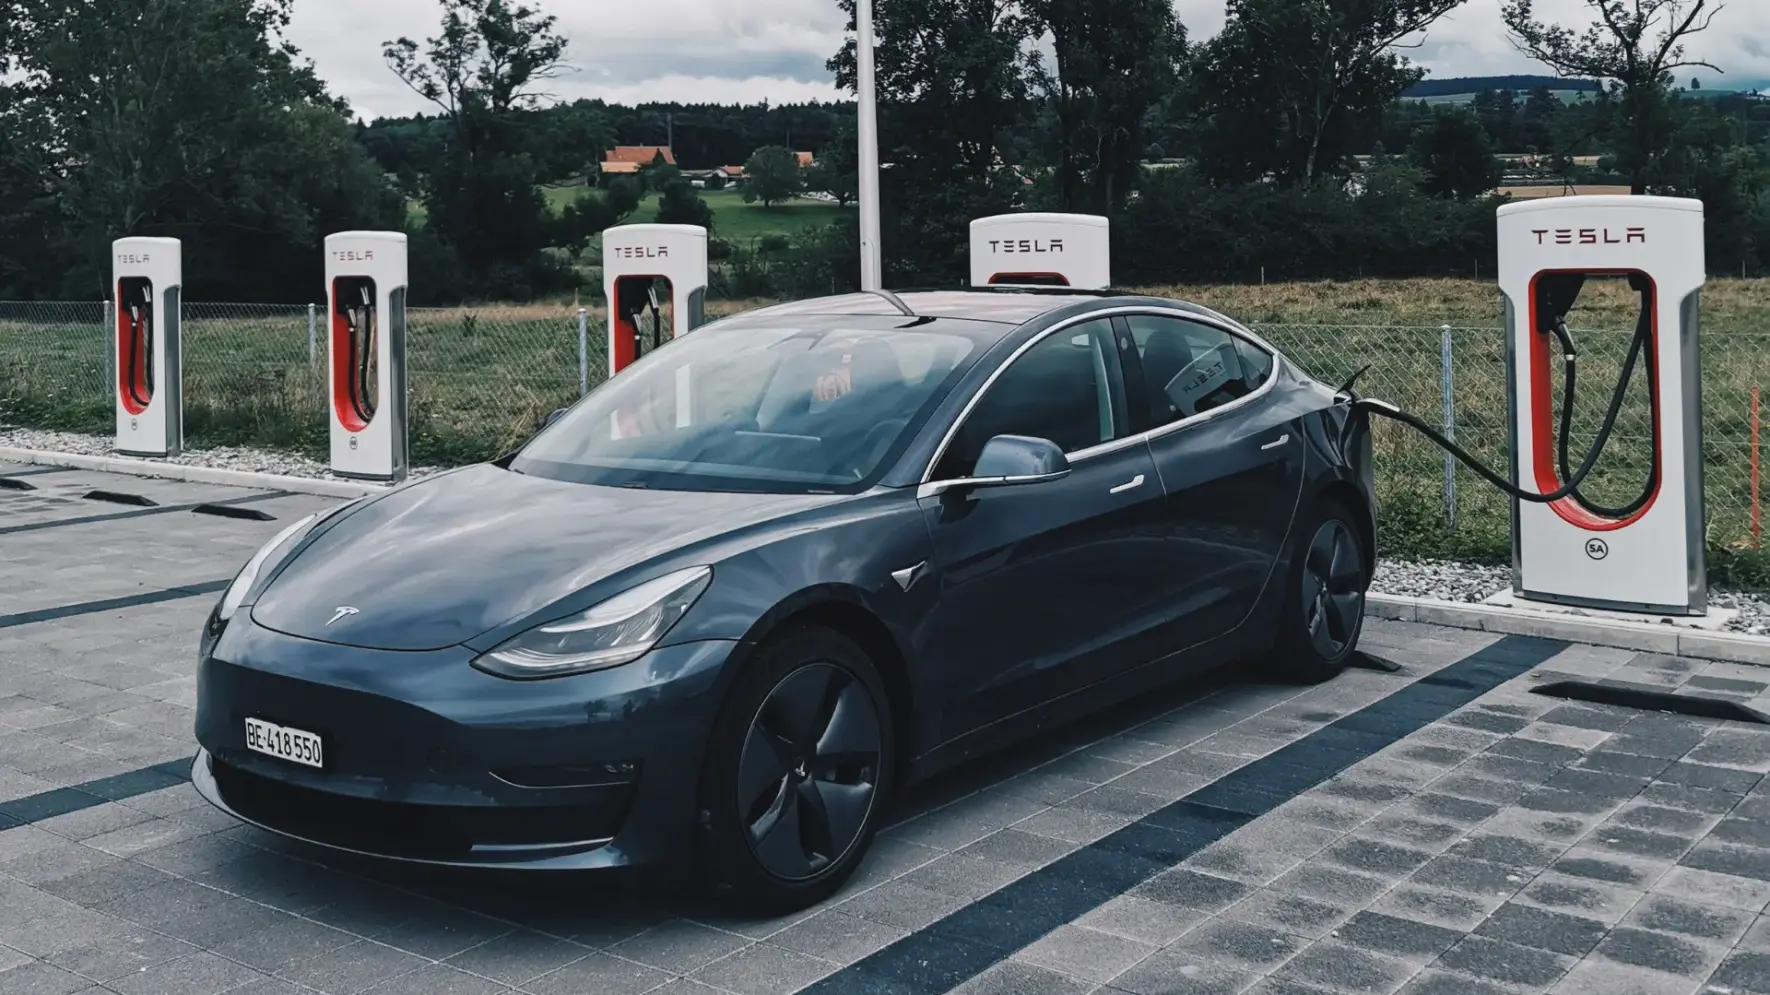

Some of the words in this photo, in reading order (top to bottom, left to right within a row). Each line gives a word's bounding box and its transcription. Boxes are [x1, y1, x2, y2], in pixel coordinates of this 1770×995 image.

[1531, 227, 1645, 244] TESLA
[989, 239, 1063, 253] TESLA
[332, 250, 373, 260] TESLA
[615, 246, 668, 258] TESLA
[117, 254, 150, 264] TESLA
[1589, 544, 1604, 554] 5A
